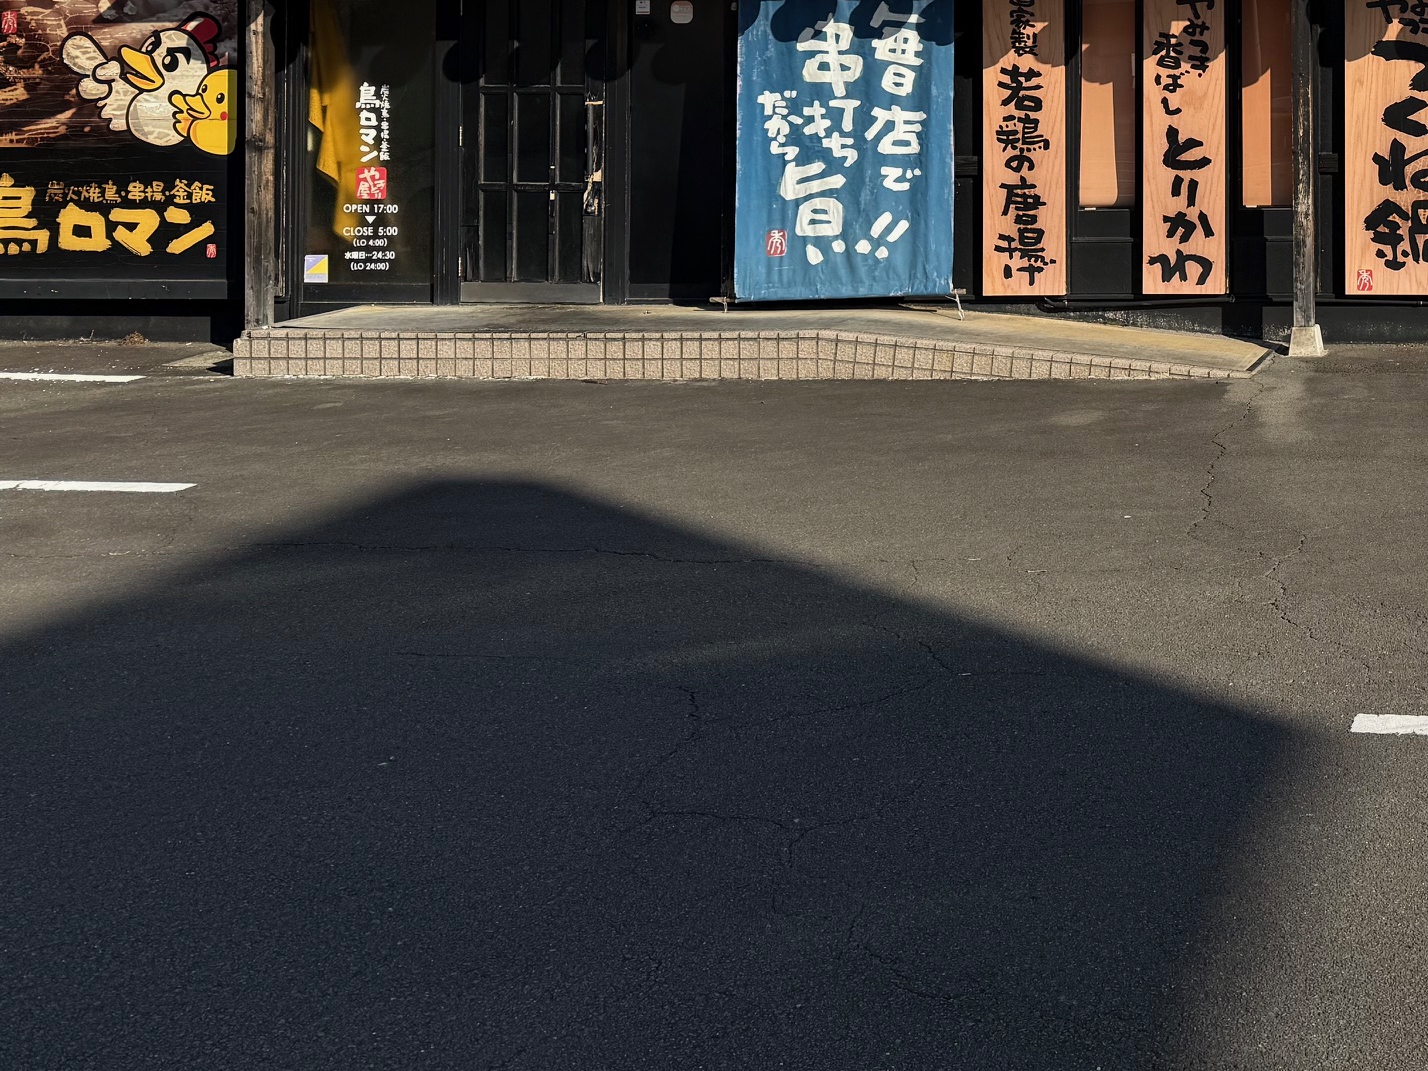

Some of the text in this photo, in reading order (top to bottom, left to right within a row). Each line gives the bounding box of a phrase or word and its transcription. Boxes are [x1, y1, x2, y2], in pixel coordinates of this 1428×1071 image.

[355, 81, 381, 162] 鳥ロマン
[343, 203, 399, 214] OPEN 17:00
[1146, 124, 1215, 286] とりかわ
[342, 226, 399, 236] CLOSE 5:00
[350, 261, 390, 271] (LO 24:00)
